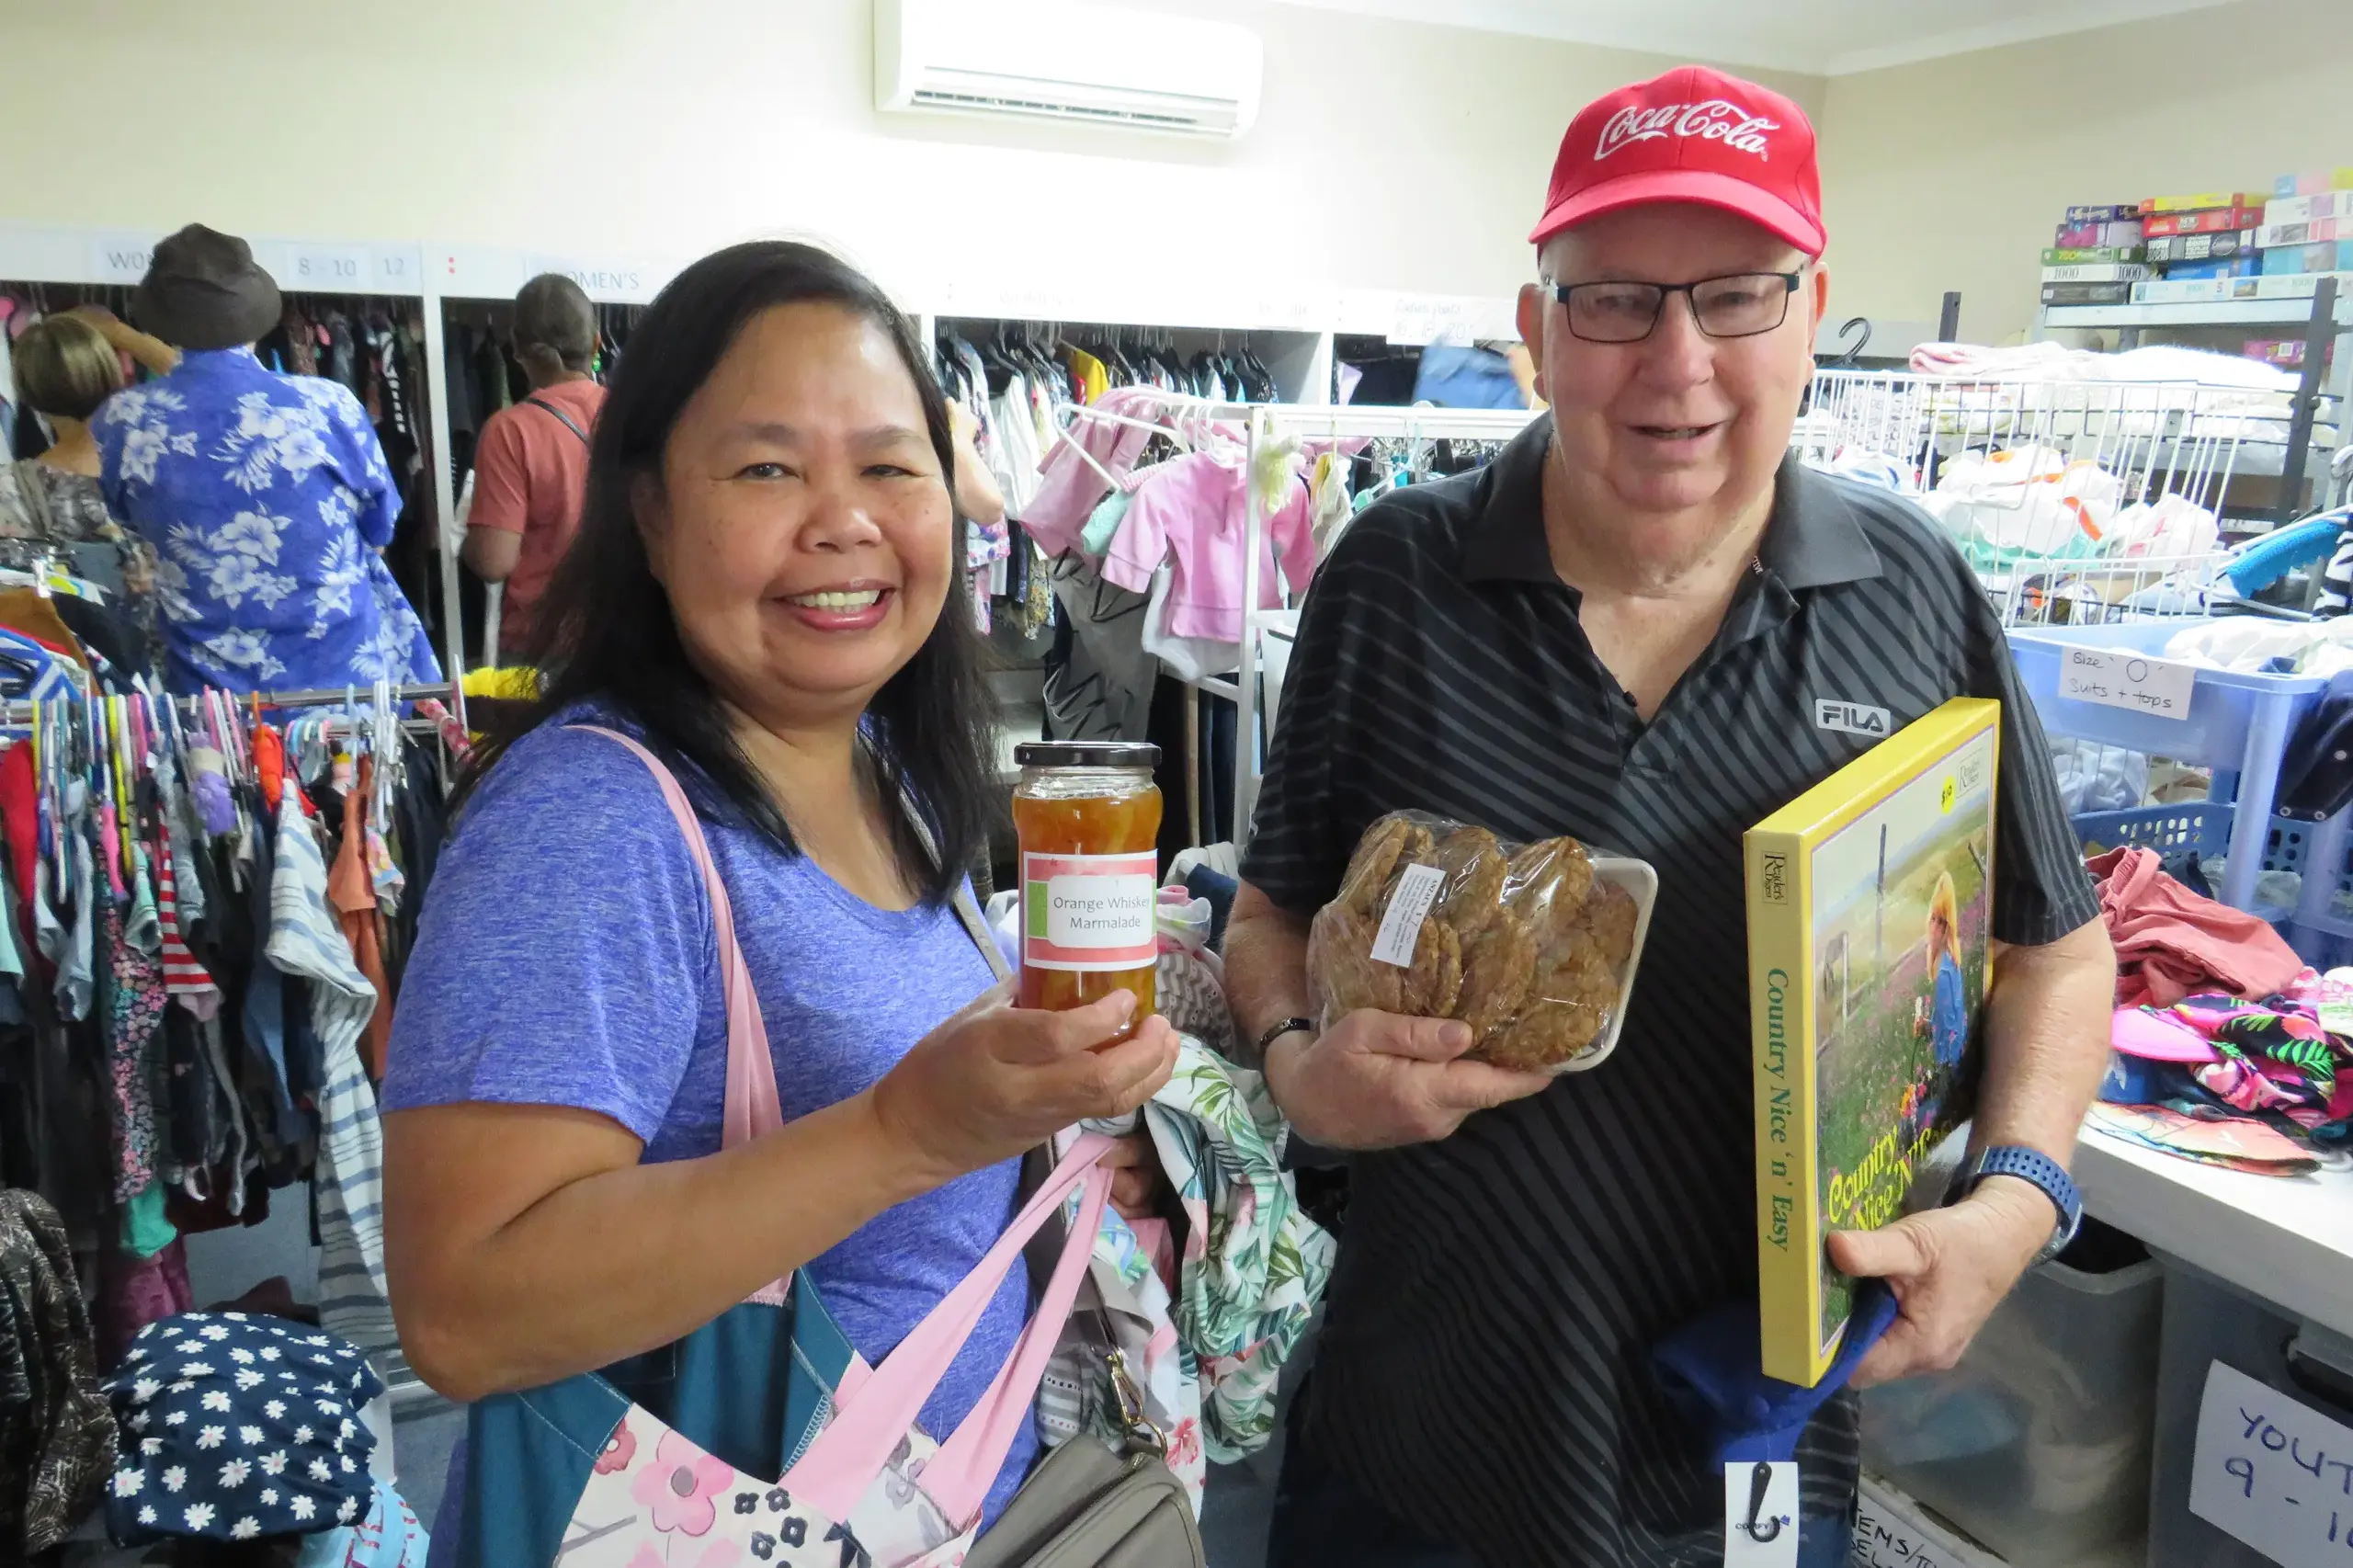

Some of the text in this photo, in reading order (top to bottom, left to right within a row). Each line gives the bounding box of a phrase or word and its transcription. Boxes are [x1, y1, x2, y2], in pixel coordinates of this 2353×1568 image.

[297, 257, 311, 276] 8
[332, 259, 357, 277] 10
[2053, 266, 2079, 280] 1000
[2117, 265, 2142, 280] 1000
[2073, 652, 2105, 669] Size
[2069, 677, 2109, 698] Suits
[2132, 690, 2172, 708] tops
[1822, 704, 1884, 733] FILA
[1053, 896, 1104, 913] Orange
[1070, 915, 1142, 929] Marmalade
[1763, 968, 1789, 1080] Country
[1769, 1085, 1791, 1143] Nice
[1829, 1125, 1898, 1223] Country
[1855, 1184, 1893, 1232] Nice
[1767, 1195, 1793, 1253] Easy
[2224, 1457, 2253, 1498] 9
